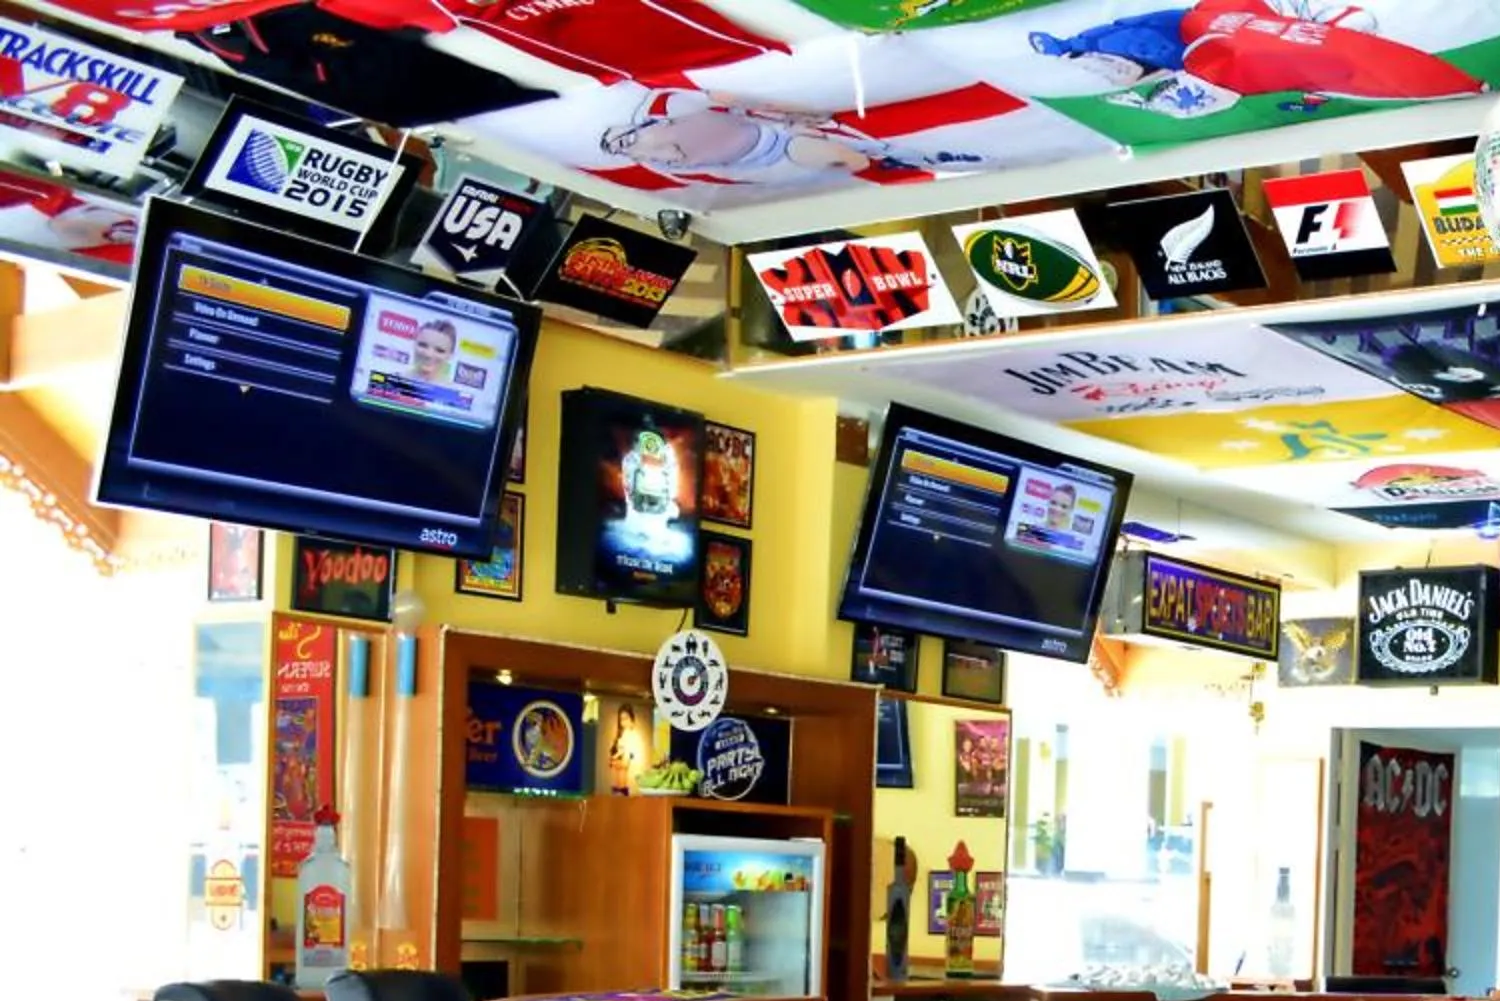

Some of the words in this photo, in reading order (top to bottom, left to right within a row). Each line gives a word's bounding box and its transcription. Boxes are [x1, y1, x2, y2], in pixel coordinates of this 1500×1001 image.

[297, 168, 349, 193] WORLD
[349, 183, 379, 201] CUP
[303, 148, 389, 188] RUGBY
[284, 179, 369, 219] 2015
[443, 195, 524, 251] USA
[1296, 201, 1362, 245] F1
[783, 282, 837, 303] SUPER
[872, 271, 923, 292] BOWL
[1168, 272, 1187, 285] ALL
[1188, 268, 1227, 284] BLACKS
[420, 526, 458, 547] astro
[304, 545, 389, 597] Voodoo
[1149, 570, 1195, 623] EXPAT
[1369, 586, 1407, 624] JACK
[1409, 578, 1475, 621] DANIEL'S
[1420, 606, 1444, 619] TIME
[1364, 753, 1449, 818] AC/DC
